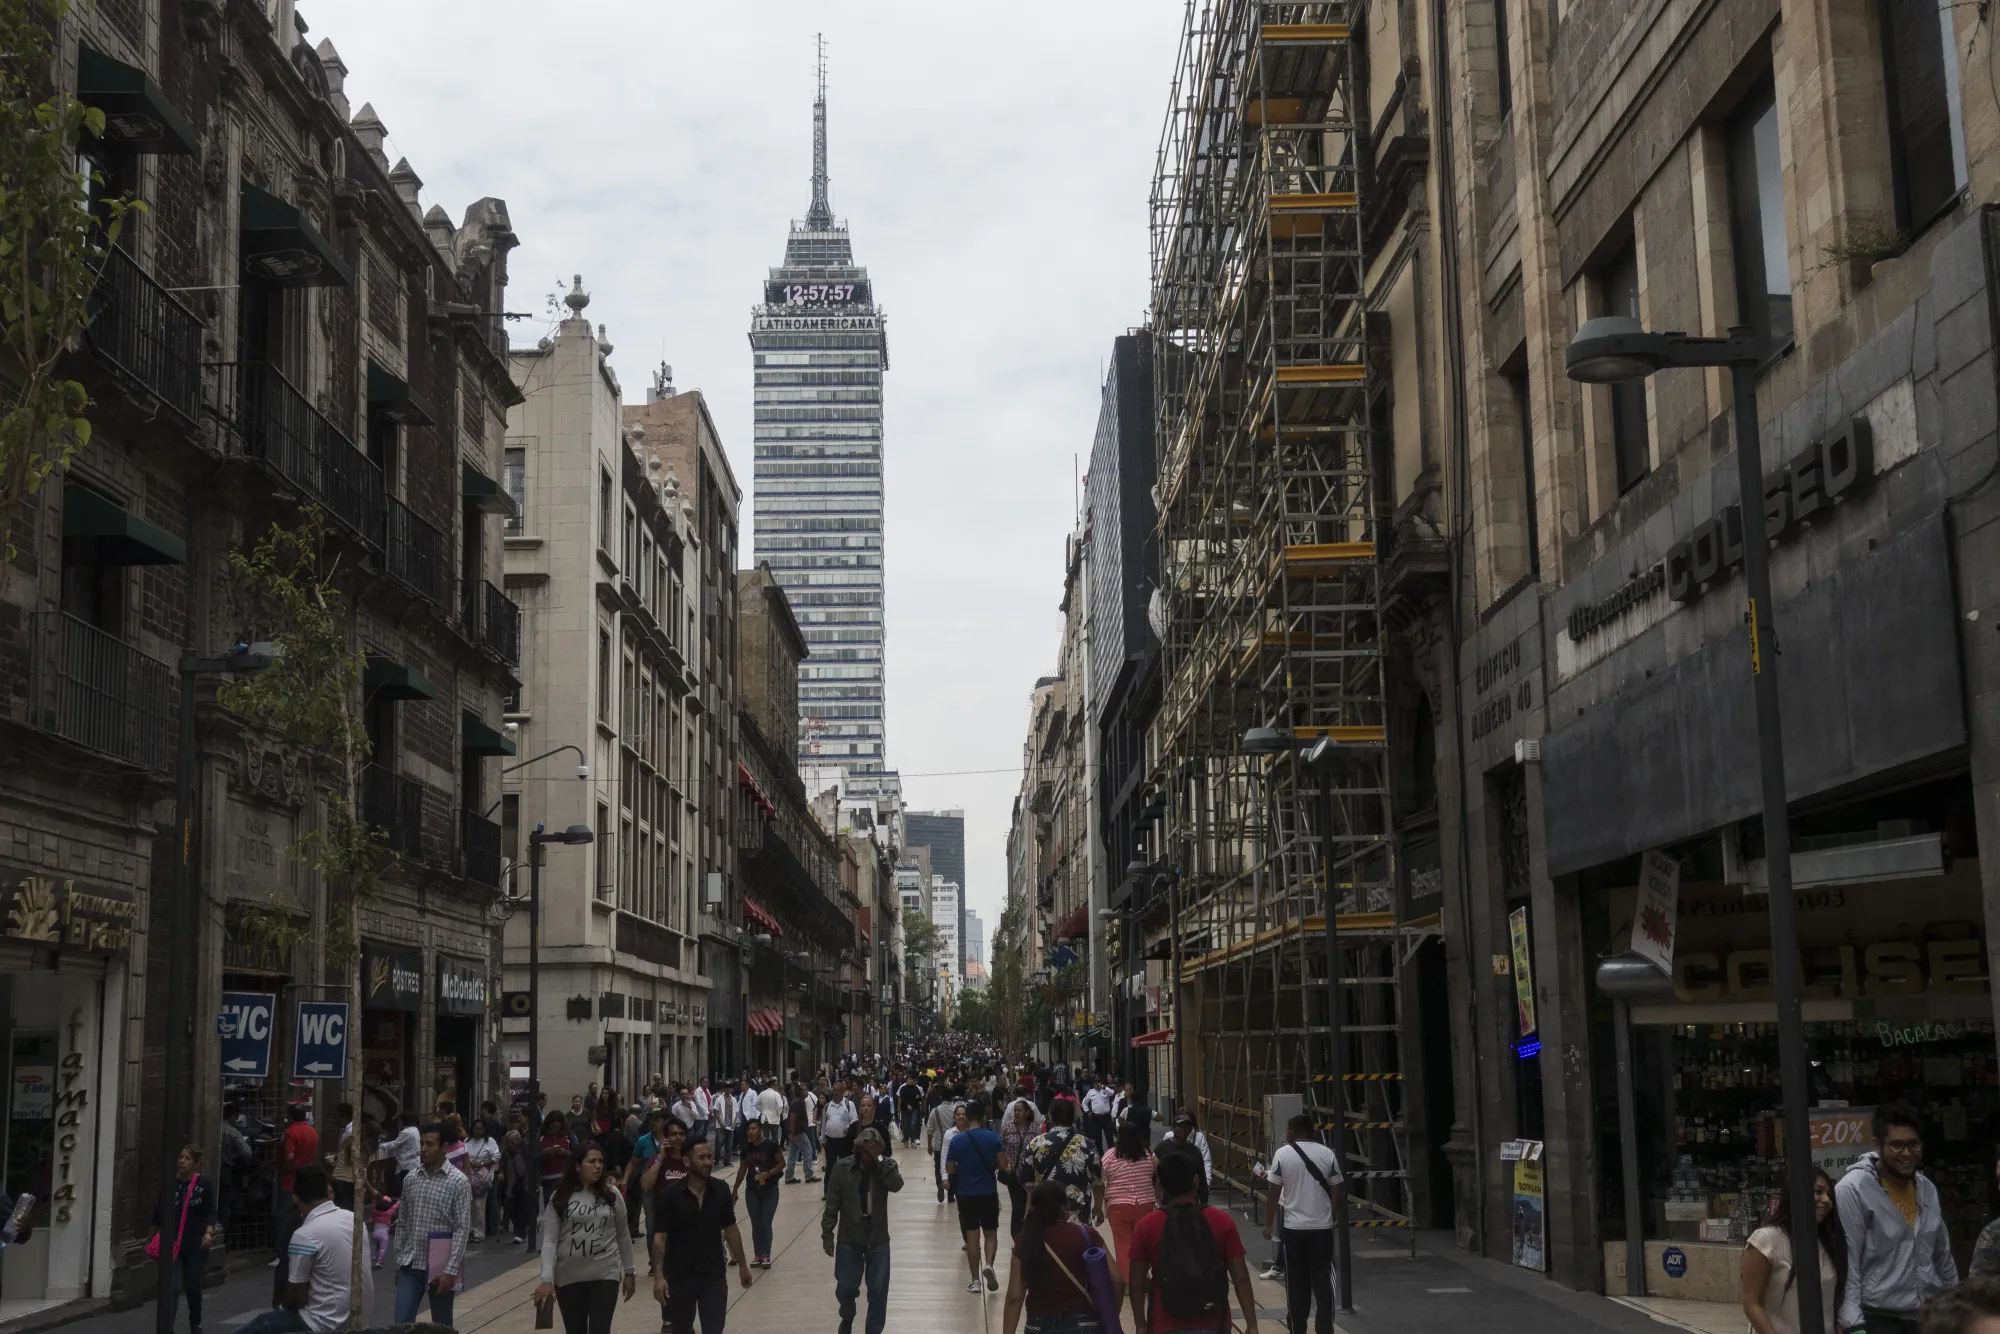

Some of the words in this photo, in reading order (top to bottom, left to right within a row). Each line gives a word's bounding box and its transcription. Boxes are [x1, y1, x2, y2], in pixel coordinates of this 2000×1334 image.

[783, 285, 854, 301] 12:57:57
[759, 318, 874, 330] LATINOAMERICANA
[1667, 416, 1874, 602] COLSEO
[1476, 639, 1520, 695] EDIFICIO
[1472, 692, 1511, 742] MADERO
[1517, 680, 1531, 712] 40
[392, 968, 419, 993] POSTRES
[1674, 939, 1982, 1003] COLISE
[442, 973, 484, 1001] McDonald's
[222, 1005, 269, 1040] WC
[302, 1014, 344, 1045] WC
[1877, 1022, 1957, 1047] BACALAO
[55, 1007, 88, 1222] farmacias
[571, 1215, 608, 1236] bug
[569, 1237, 606, 1257] ME
[1666, 1254, 1682, 1265] ADT
